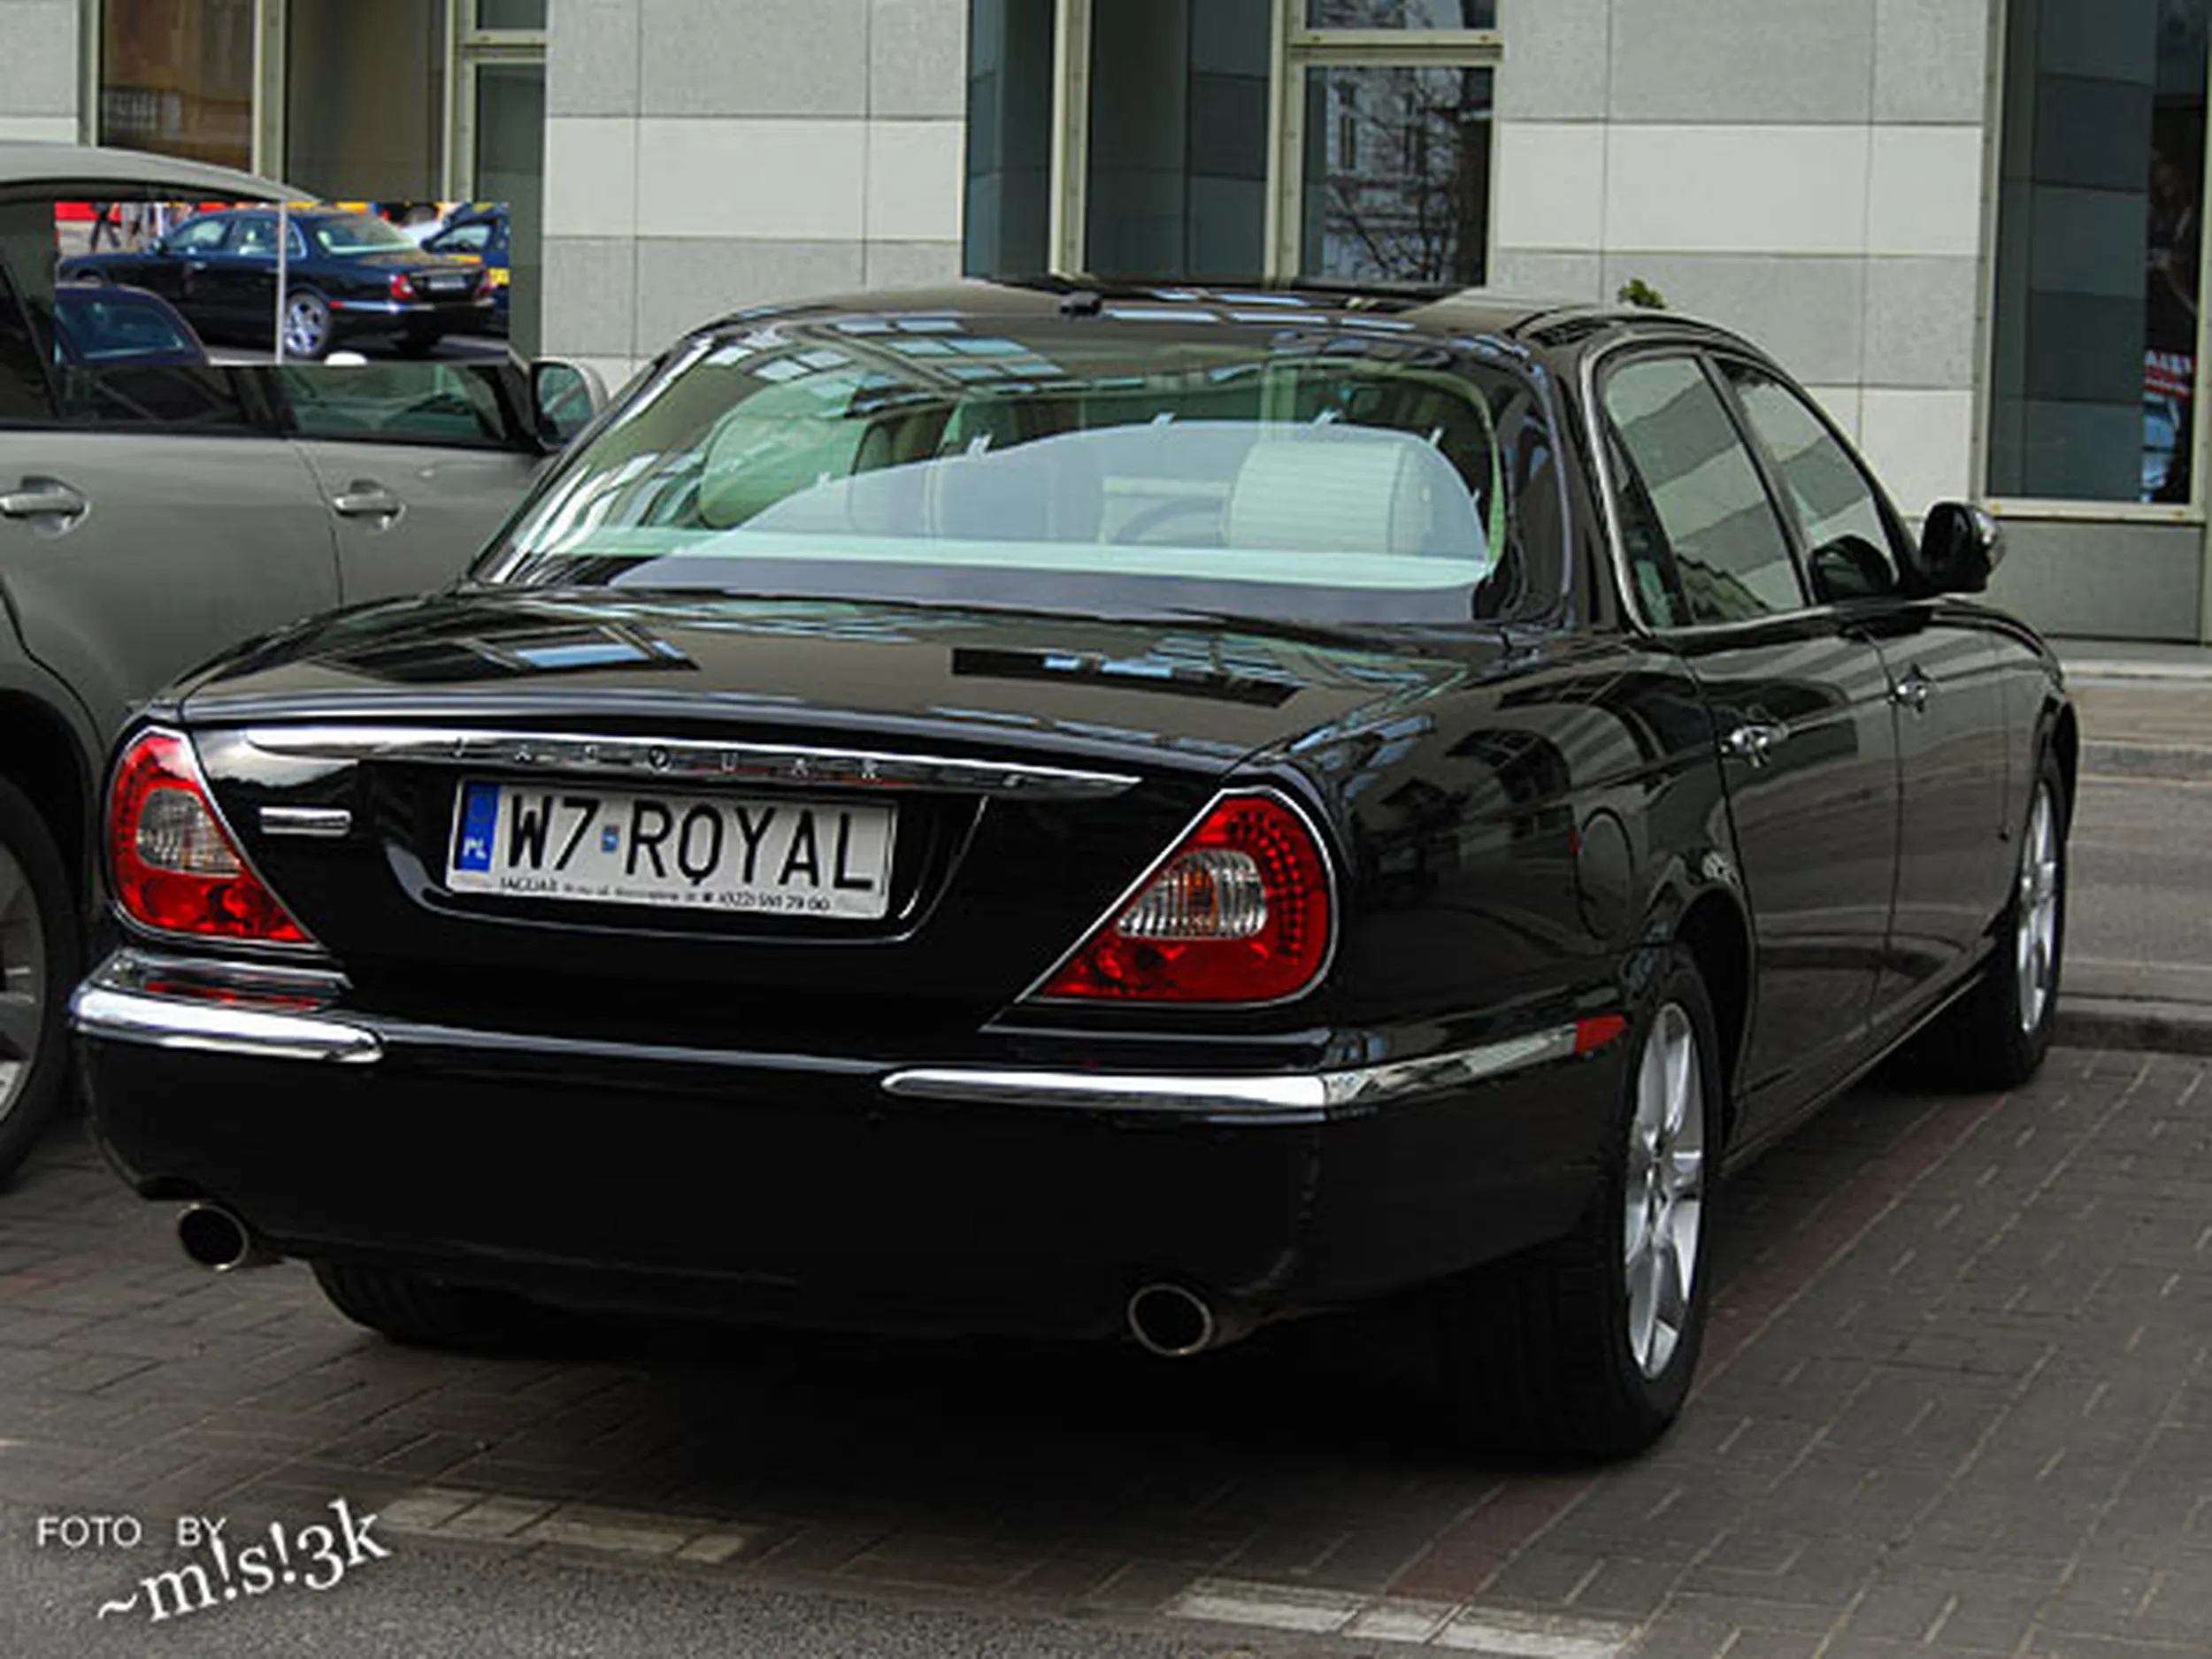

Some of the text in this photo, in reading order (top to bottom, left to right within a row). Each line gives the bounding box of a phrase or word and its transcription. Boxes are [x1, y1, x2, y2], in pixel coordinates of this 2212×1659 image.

[462, 836, 487, 859] PL
[509, 795, 874, 890] W7 ROYAL
